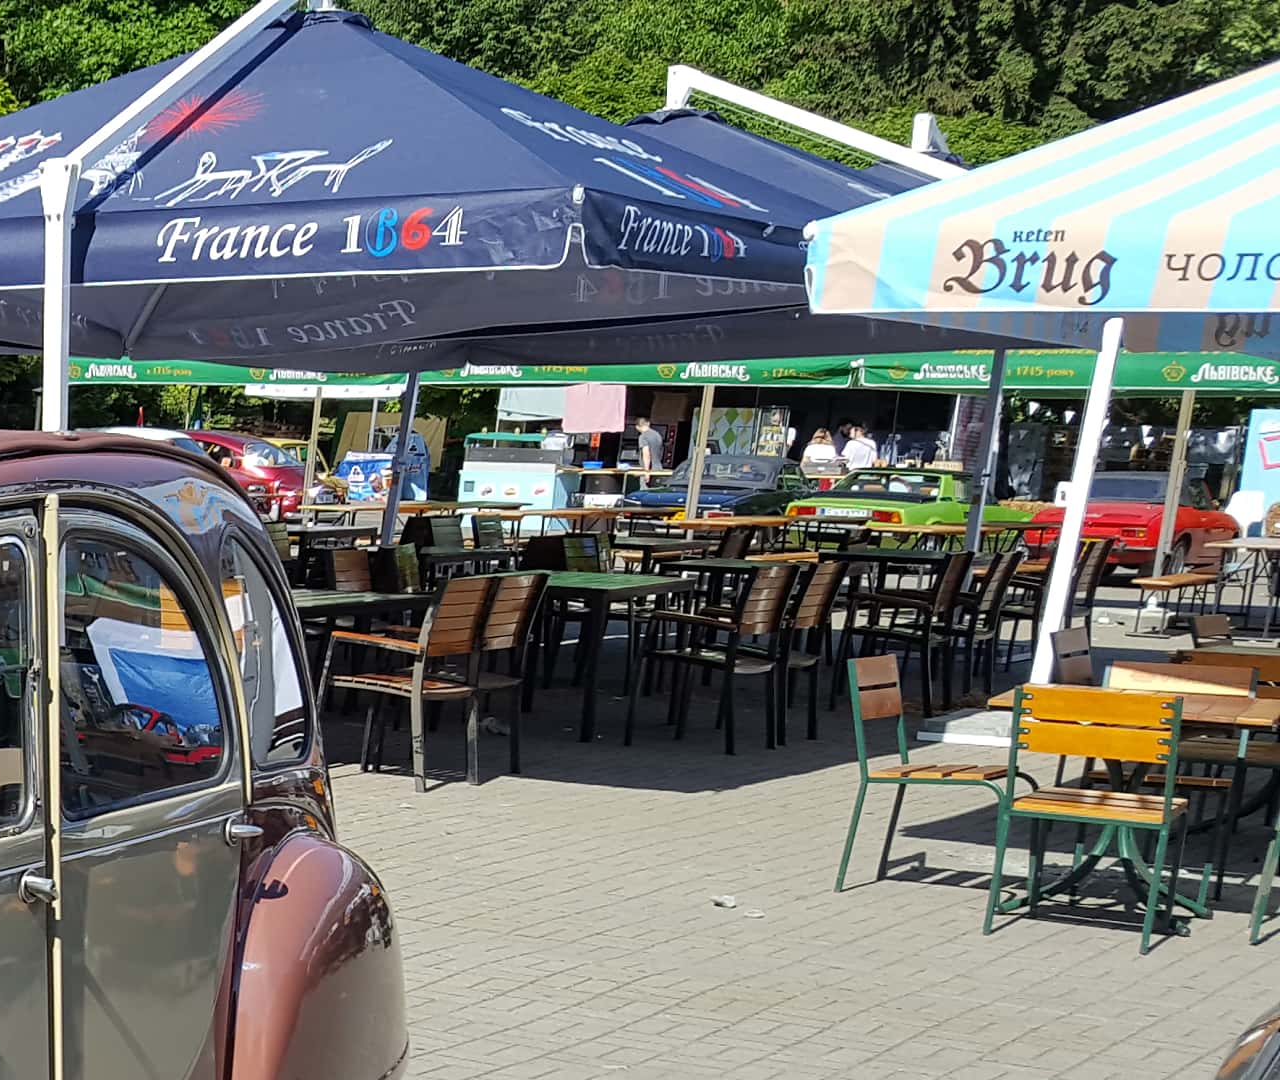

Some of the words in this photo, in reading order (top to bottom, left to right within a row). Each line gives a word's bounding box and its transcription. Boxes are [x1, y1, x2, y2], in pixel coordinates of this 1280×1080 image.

[156, 216, 318, 262] France
[618, 205, 692, 256] France
[943, 238, 1118, 306] Brug
